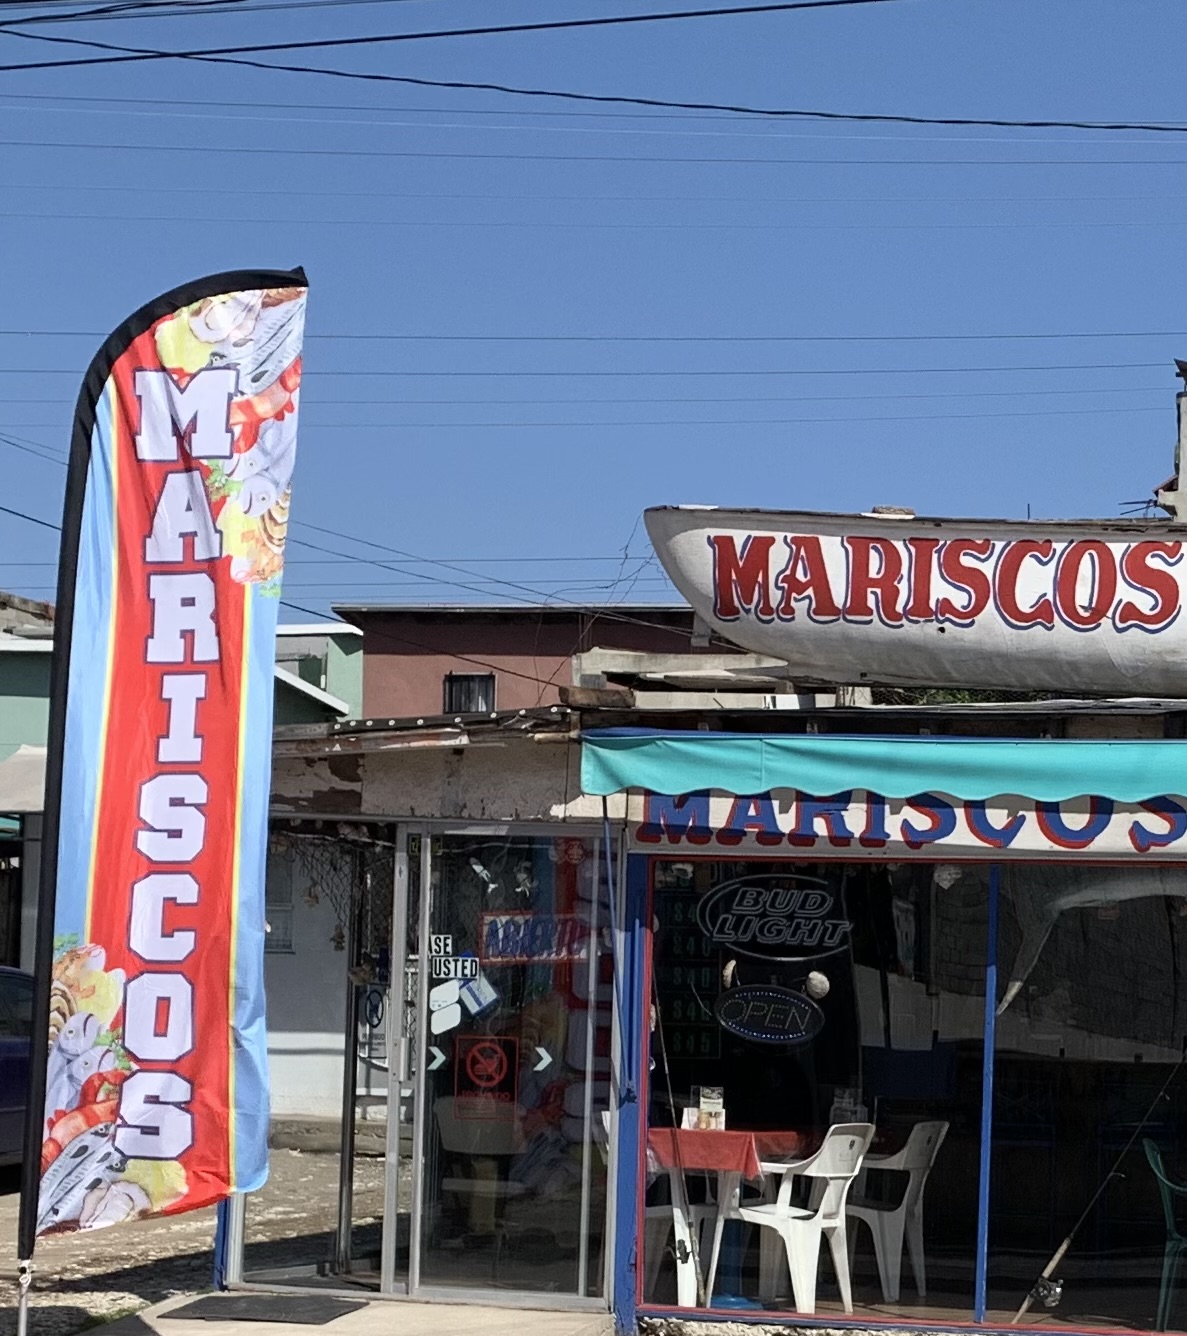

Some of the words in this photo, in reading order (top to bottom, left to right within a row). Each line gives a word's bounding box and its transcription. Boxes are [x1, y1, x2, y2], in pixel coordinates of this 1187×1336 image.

[706, 532, 1183, 634] MARISCOS
[112, 366, 240, 1160] MARISCOS
[732, 887, 834, 916] BUD
[712, 914, 854, 946] LIGHT
[434, 958, 478, 978] USTED
[720, 998, 812, 1032] OPEN
